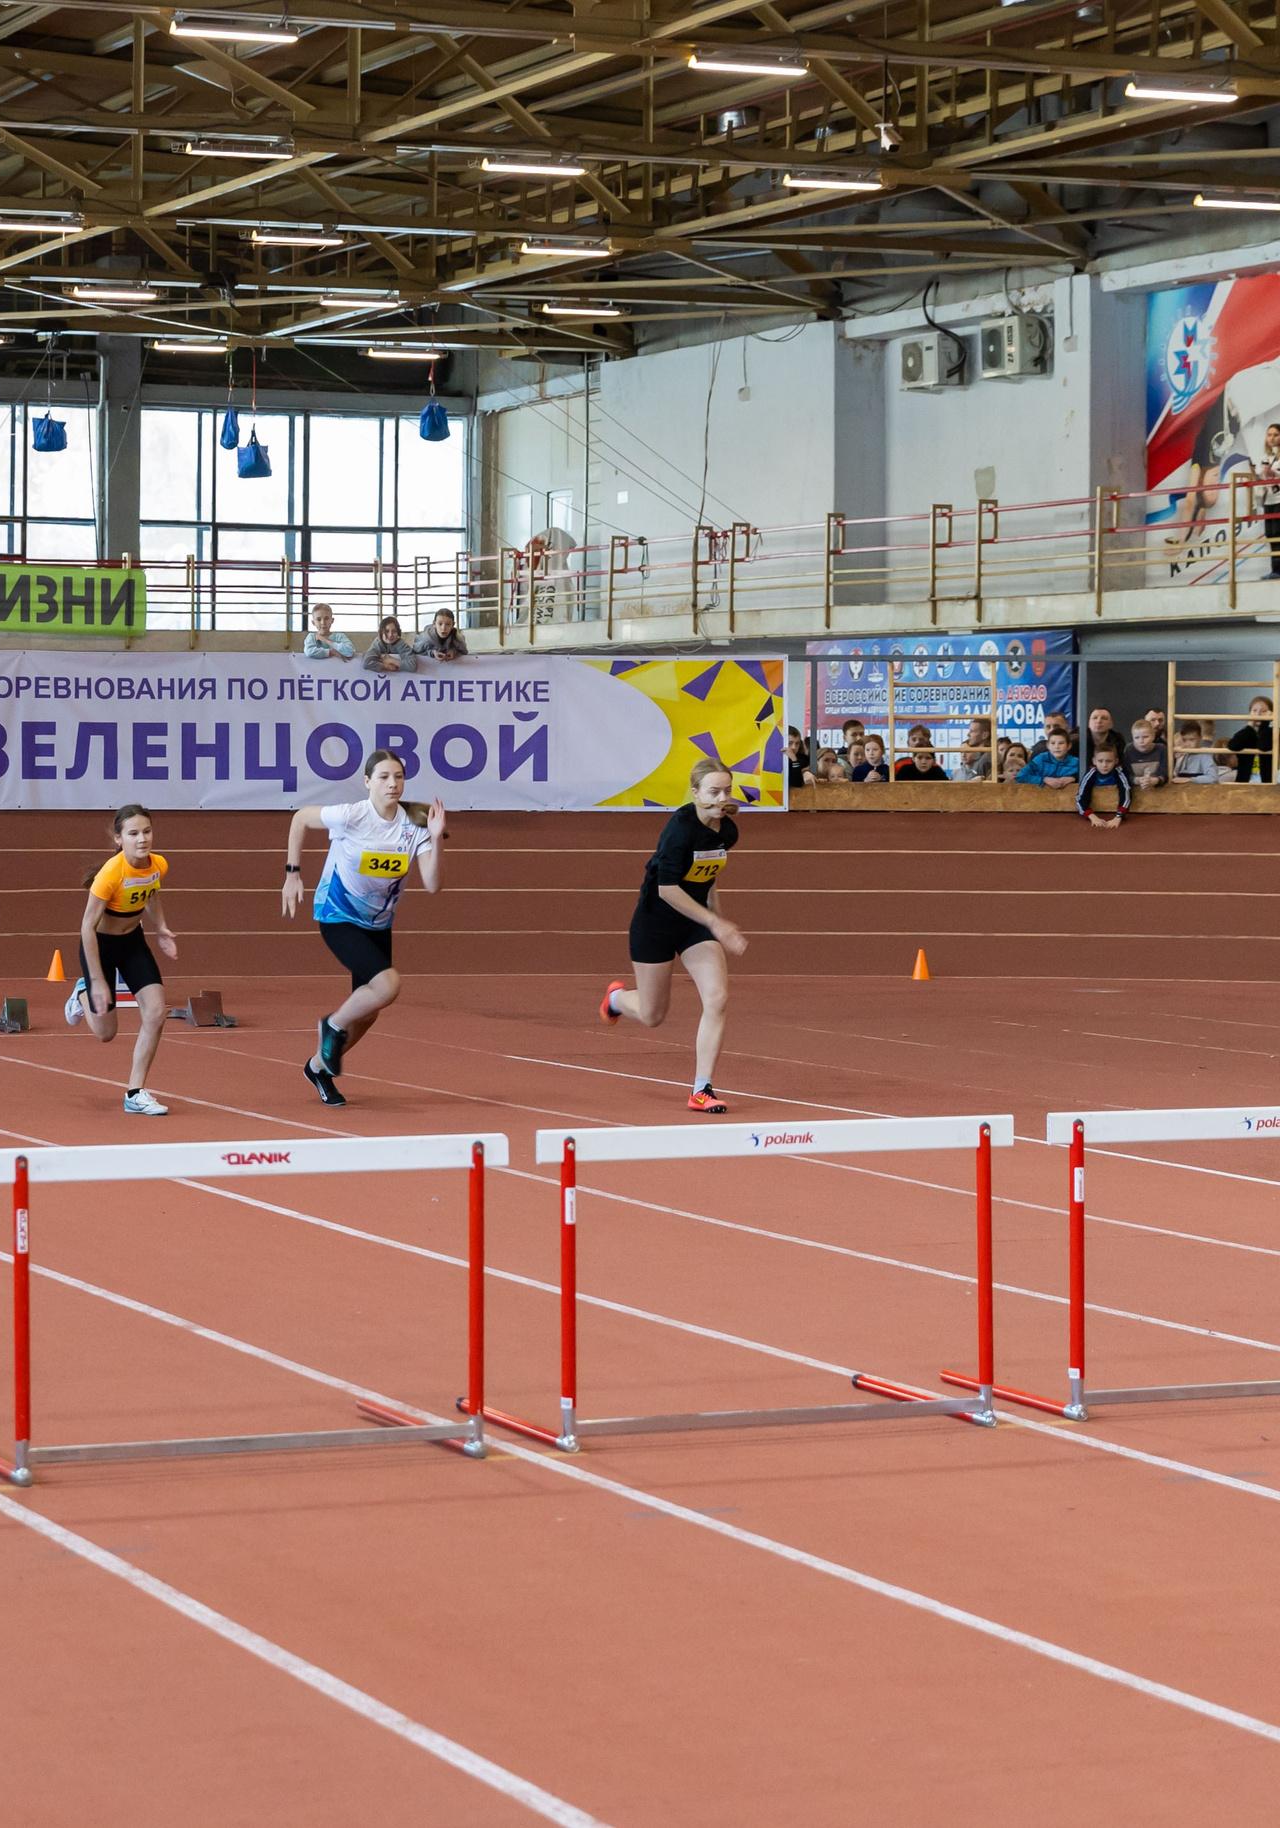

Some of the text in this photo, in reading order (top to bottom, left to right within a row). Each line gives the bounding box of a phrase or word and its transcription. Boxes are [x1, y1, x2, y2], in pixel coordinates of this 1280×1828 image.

[228, 679, 267, 700] ПО
[277, 675, 391, 701] ЛЁГКОЙ
[401, 680, 549, 702] АТЛЕТИКЕ
[825, 685, 906, 704] ВСЕРОССИЙСИЕ
[909, 687, 991, 703] СОРЕВНОВАНИЯ
[1006, 684, 1048, 702] ДЗЮДО
[369, 858, 401, 872] 342
[694, 865, 720, 876] 712
[764, 1130, 816, 1148] polanik
[222, 1152, 291, 1165] OLANIK
